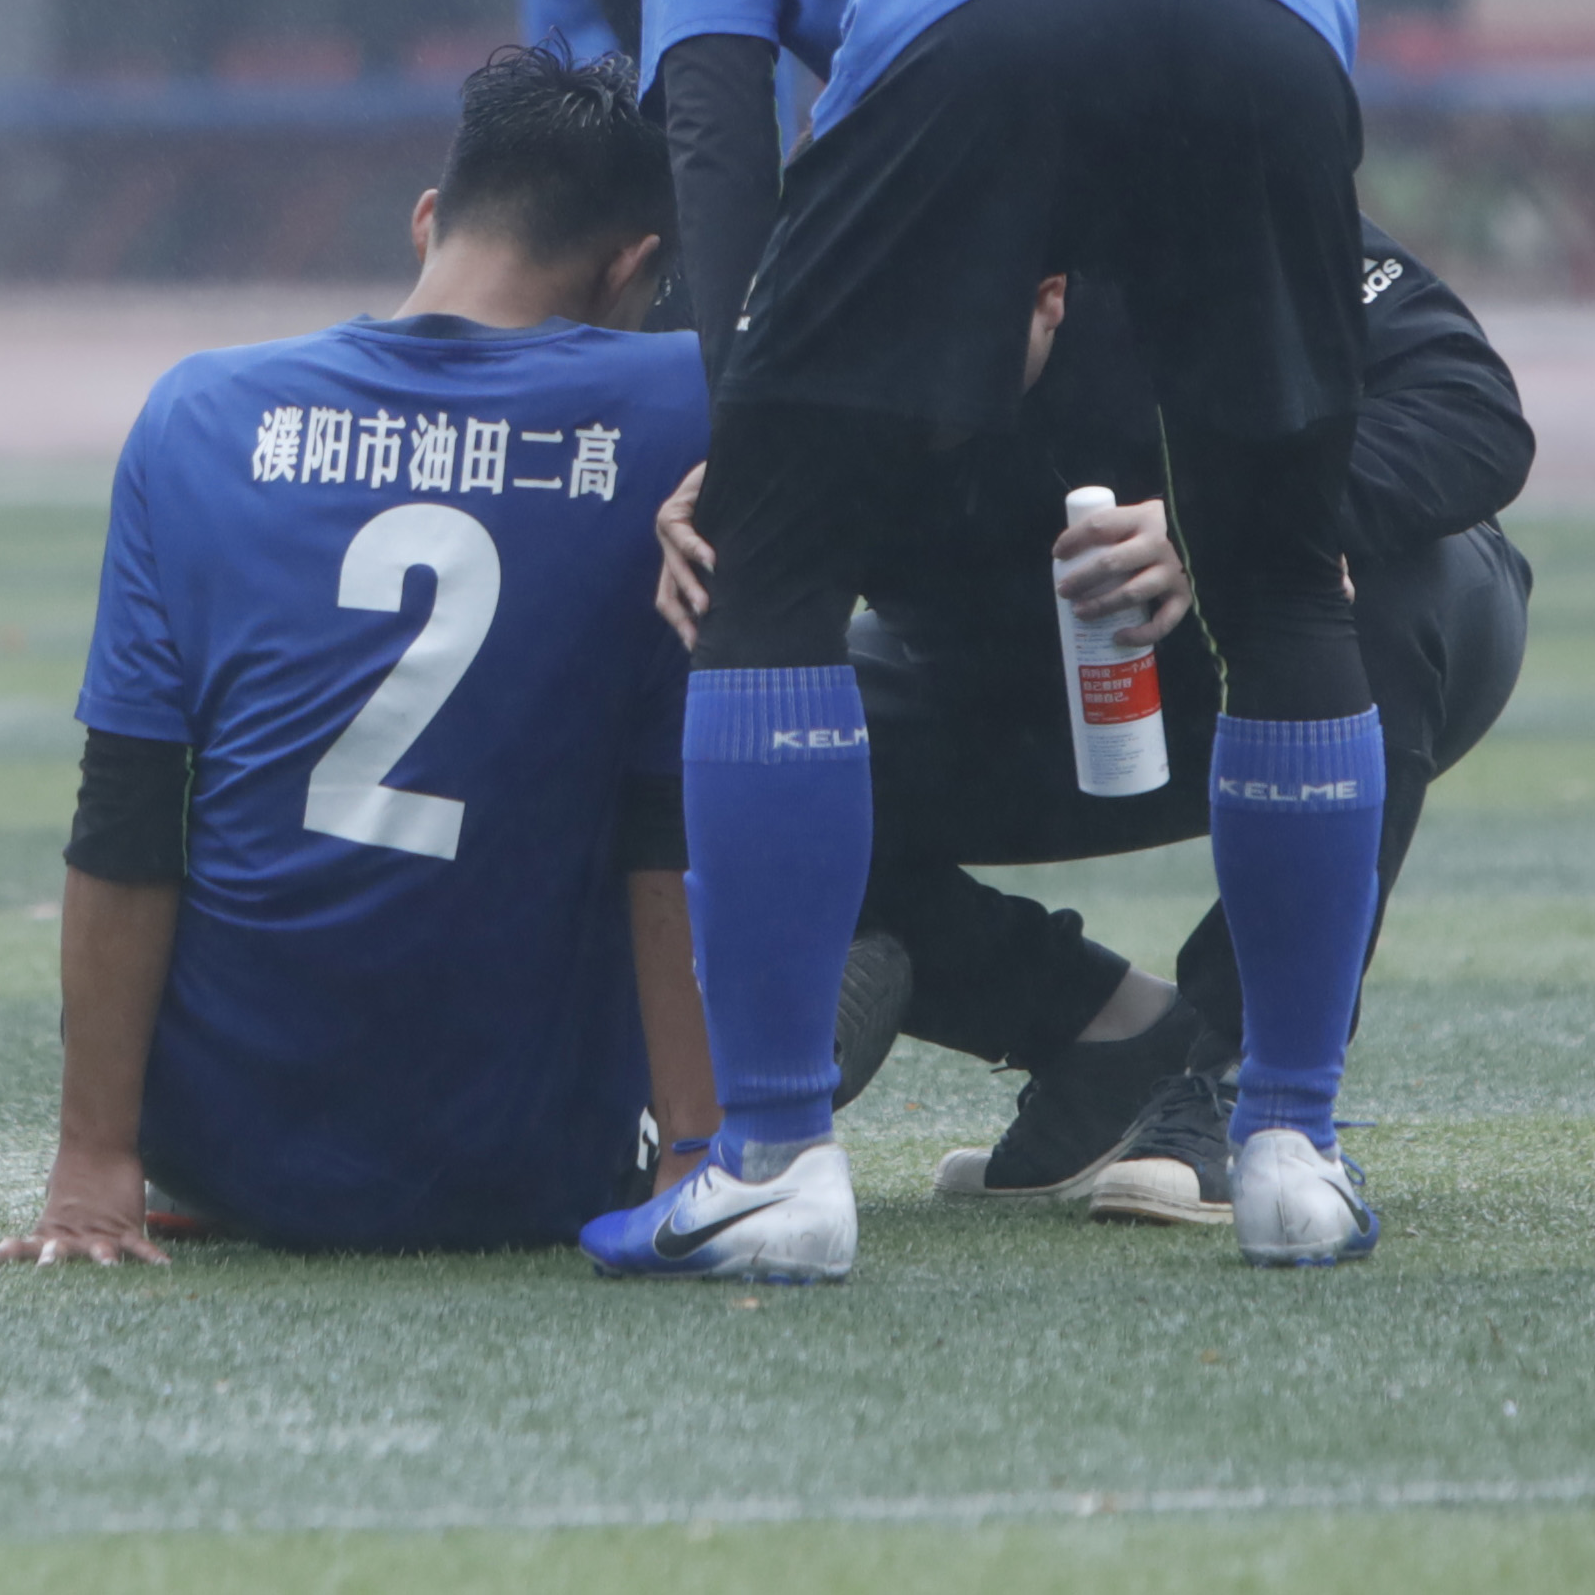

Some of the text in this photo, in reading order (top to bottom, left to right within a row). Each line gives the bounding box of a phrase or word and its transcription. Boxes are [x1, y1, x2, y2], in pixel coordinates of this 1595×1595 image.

[251, 405, 622, 502] 濮阳市油田二高
[303, 502, 502, 861] 2
[772, 725, 868, 750] KELM
[1219, 777, 1358, 802] KELME
